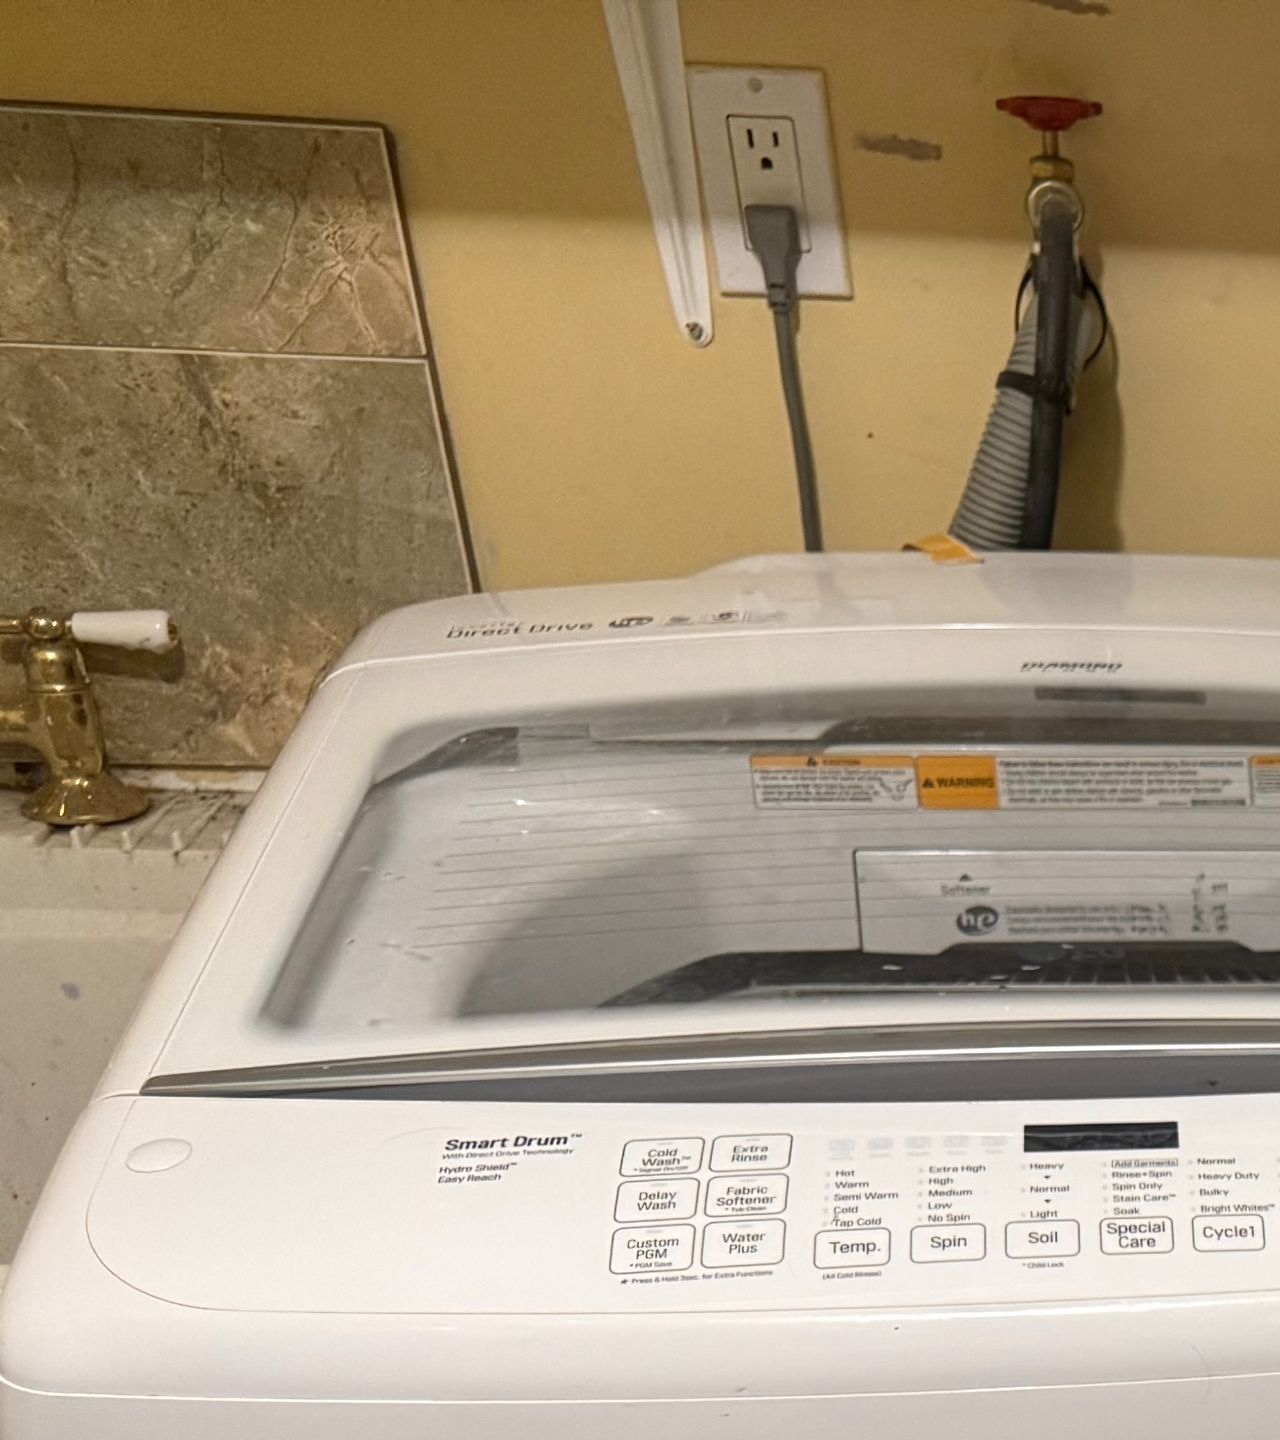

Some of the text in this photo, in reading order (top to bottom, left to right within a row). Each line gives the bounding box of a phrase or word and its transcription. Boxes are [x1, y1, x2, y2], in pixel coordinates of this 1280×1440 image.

[528, 622, 595, 635] Drive
[445, 1136, 509, 1151] Smart
[523, 1148, 575, 1156] Technology
[647, 1148, 678, 1158] Cold
[733, 1145, 768, 1153] Extra
[731, 1153, 768, 1163] Rinse
[438, 1165, 473, 1175] Hydro
[928, 1165, 987, 1174] Extra High
[1030, 1163, 1064, 1171] Heavy
[835, 1169, 855, 1177] Hot
[1198, 1171, 1260, 1181] Heavy Duty
[437, 1174, 502, 1184] Easy Reach
[928, 1177, 954, 1186] High
[727, 1186, 768, 1195] Fabric
[1030, 1185, 1070, 1193] Normal
[1112, 1181, 1163, 1191] Spin Only
[638, 1191, 677, 1202] Delay
[833, 1192, 899, 1202] Semi Warm
[928, 1189, 973, 1197] Medium
[1199, 1188, 1230, 1197] Bulky
[716, 1196, 776, 1207] Softener
[1112, 1194, 1141, 1203] Stain
[637, 1200, 676, 1211] Wash
[833, 1206, 859, 1214] Cold
[927, 1202, 953, 1210] Low
[1200, 1204, 1232, 1214] Bright
[1030, 1210, 1058, 1219] Light
[1113, 1207, 1140, 1215] Soak
[833, 1217, 882, 1228] Tap Cold
[927, 1213, 971, 1223] No Spin
[1106, 1221, 1166, 1236] Special
[1202, 1225, 1255, 1240] Cycle1
[722, 1233, 766, 1243] Water
[930, 1235, 968, 1250] Spin
[1028, 1231, 1058, 1244] Soil
[1118, 1236, 1156, 1249] Care
[627, 1238, 680, 1249] Custom
[728, 1243, 757, 1254] Plus
[829, 1241, 882, 1255] Temp.
[636, 1249, 668, 1260] PGM
